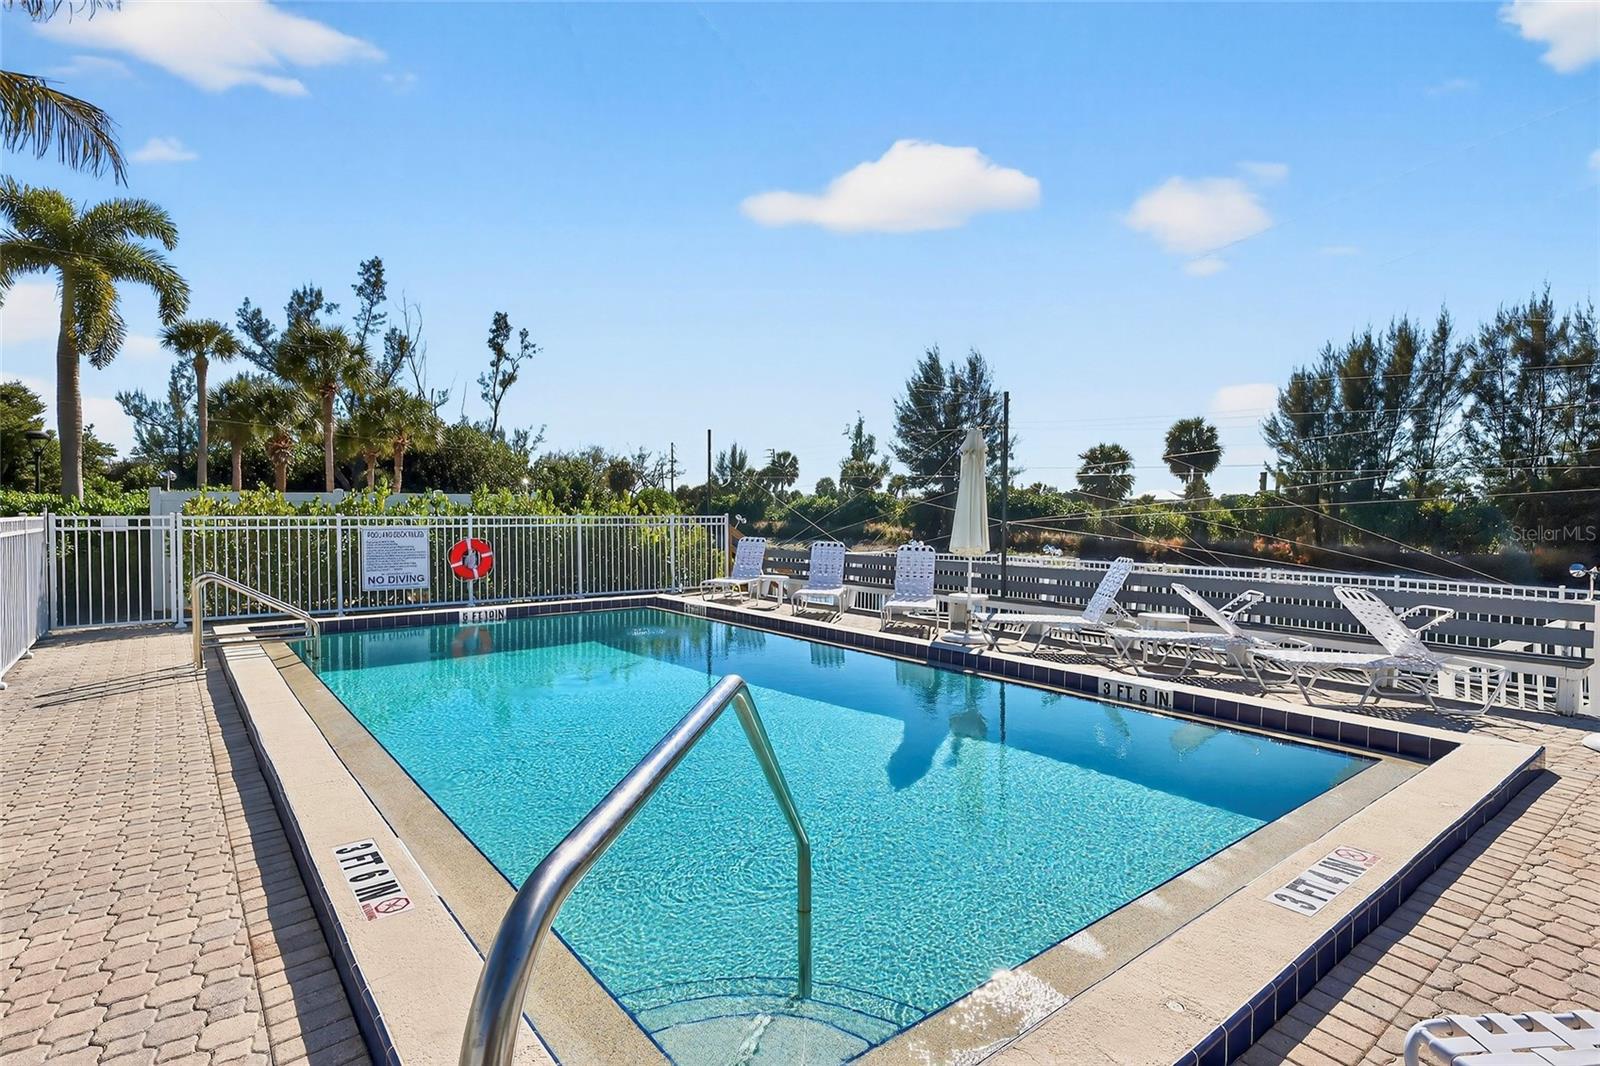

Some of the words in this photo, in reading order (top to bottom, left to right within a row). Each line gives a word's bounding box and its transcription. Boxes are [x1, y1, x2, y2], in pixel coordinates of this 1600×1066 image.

[368, 576, 385, 585] NO
[388, 574, 425, 584] DIVING
[1103, 682, 1111, 695] 3
[1140, 689, 1148, 702] 6
[335, 843, 373, 854] 3
[340, 851, 384, 870] FT
[1319, 857, 1367, 877] IN
[349, 869, 390, 882] 6
[1308, 869, 1350, 884] 4
[355, 880, 401, 902] IN
[1285, 879, 1336, 902] FT
[1274, 893, 1317, 910] 3
